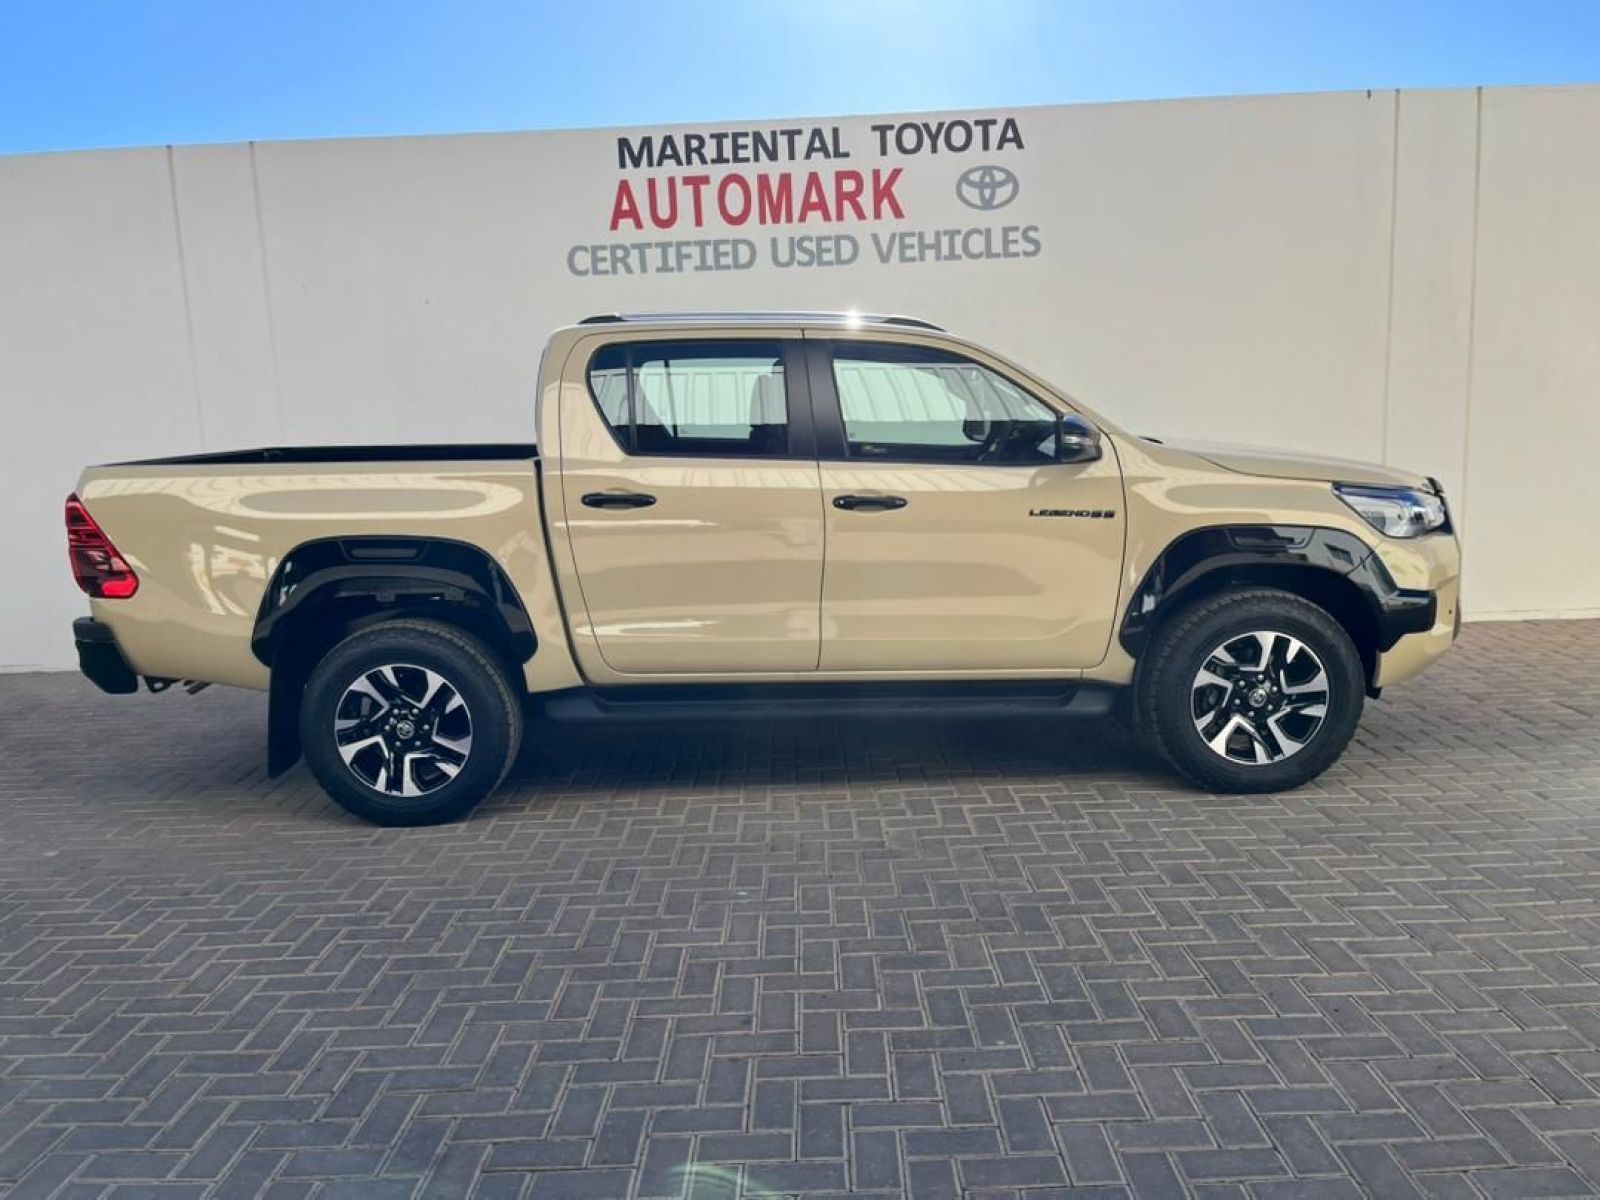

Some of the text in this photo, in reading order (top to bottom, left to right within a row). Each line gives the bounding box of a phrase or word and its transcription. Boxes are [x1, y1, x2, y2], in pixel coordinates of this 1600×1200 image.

[618, 118, 1025, 168] MARIENTAL TOYOTA
[609, 168, 905, 231] AUTOMARK
[567, 226, 1041, 277] CERTIFIED USED VEHICLES
